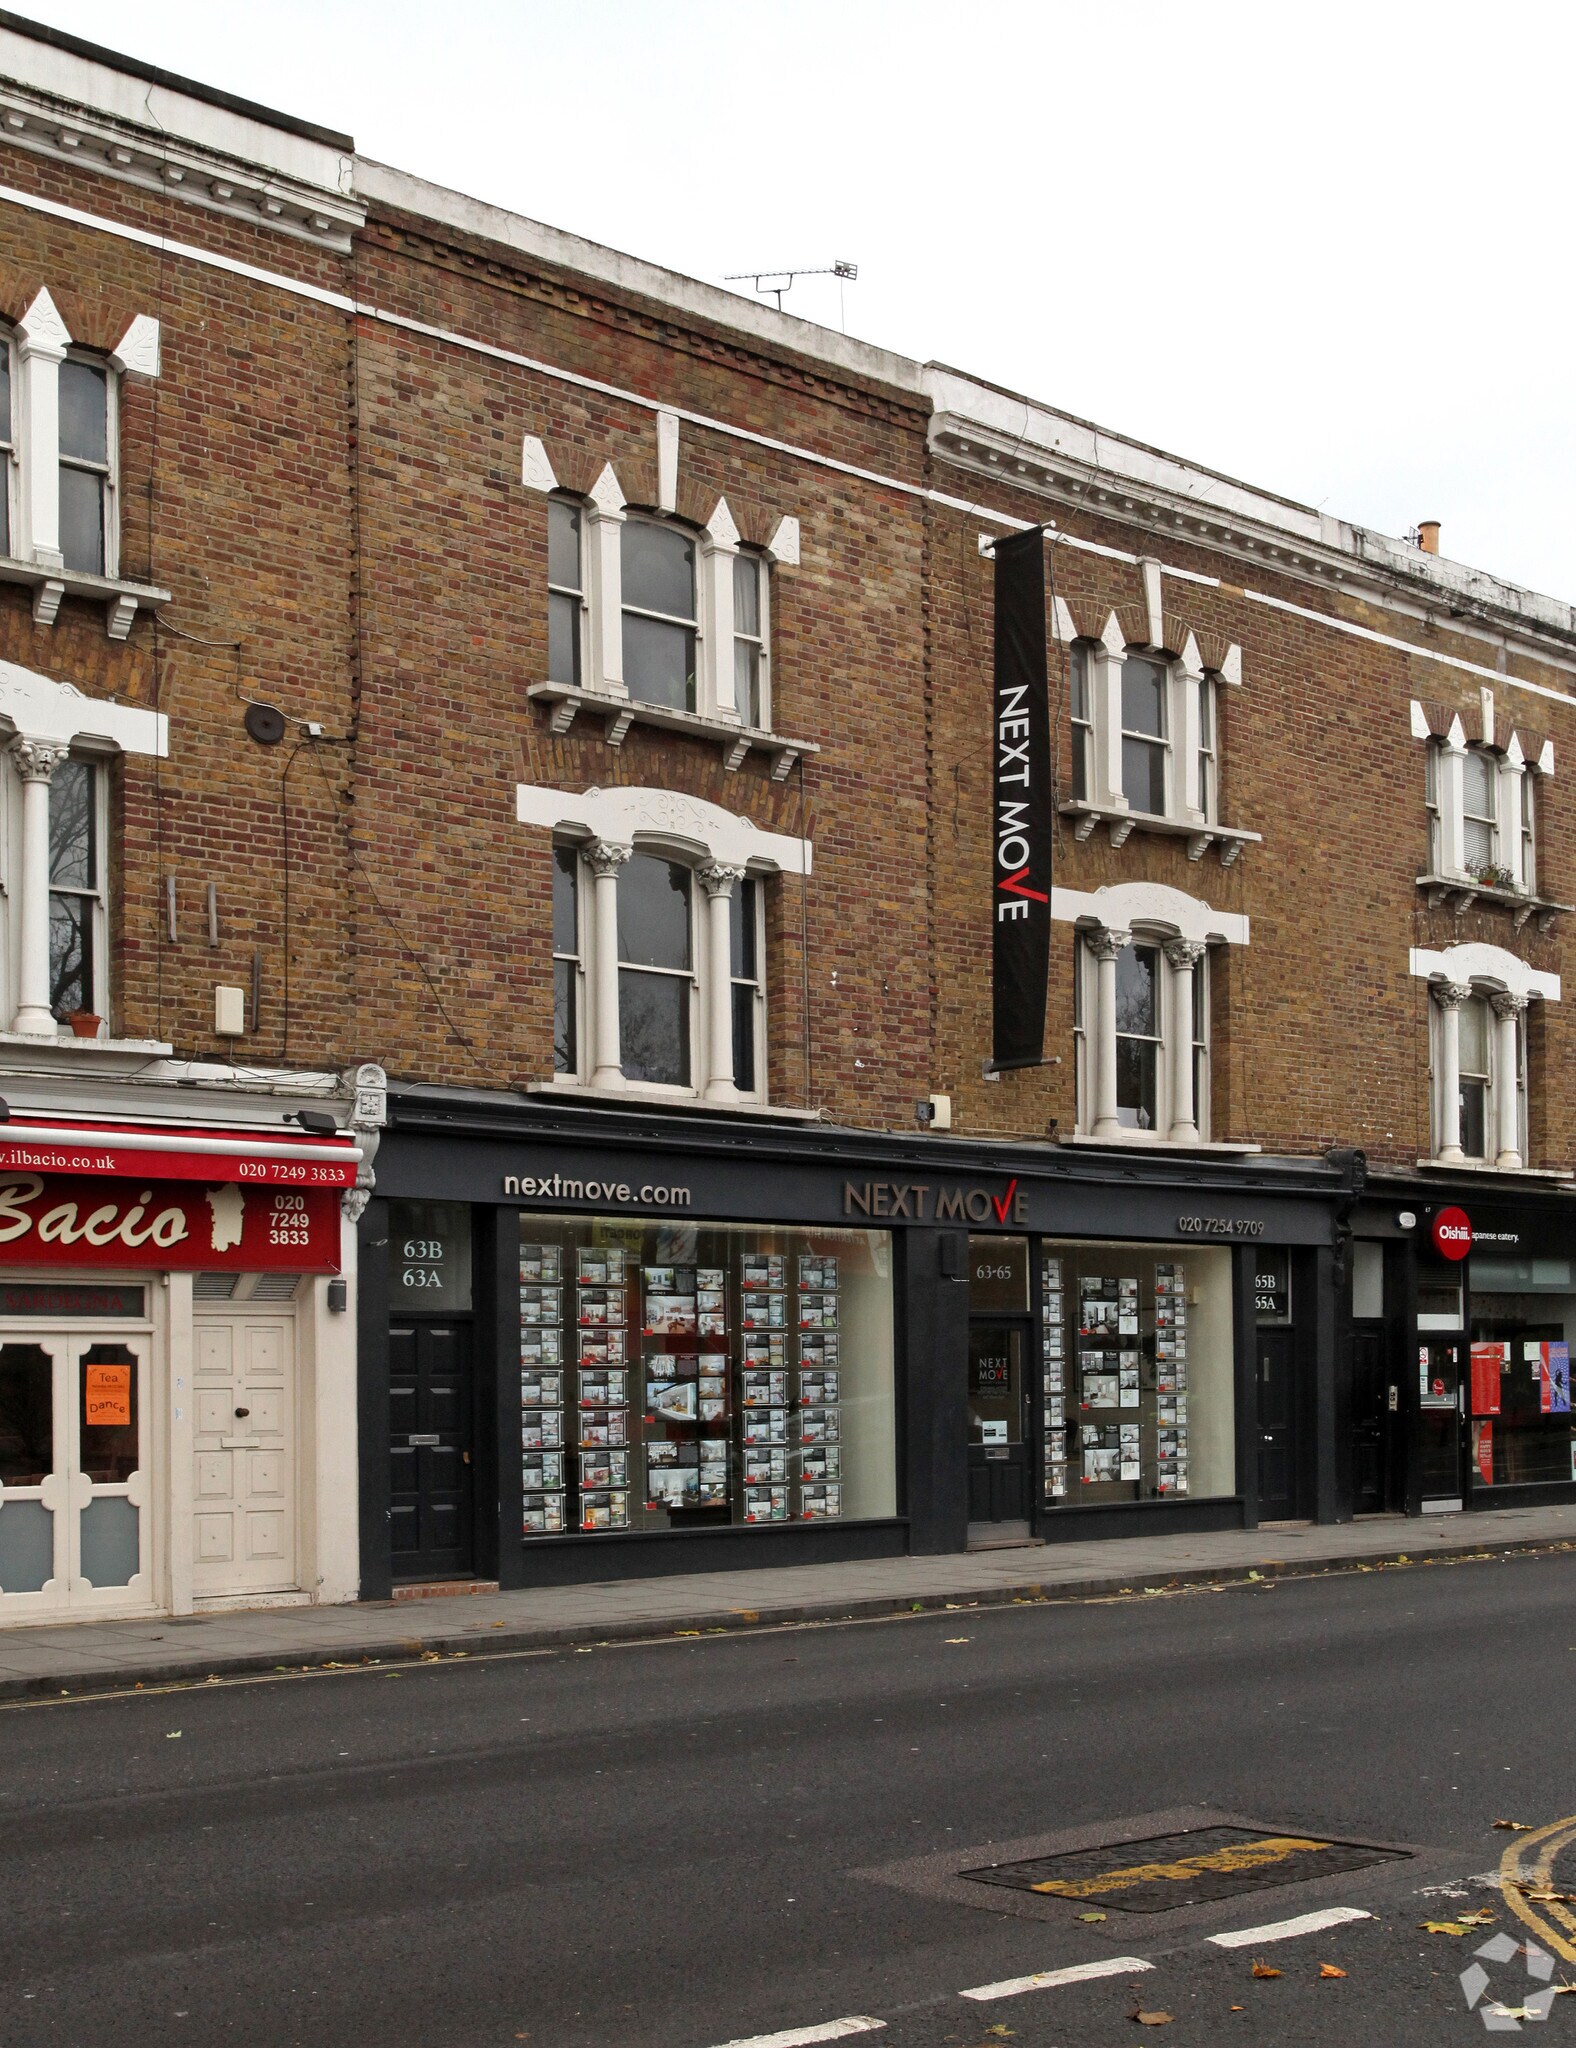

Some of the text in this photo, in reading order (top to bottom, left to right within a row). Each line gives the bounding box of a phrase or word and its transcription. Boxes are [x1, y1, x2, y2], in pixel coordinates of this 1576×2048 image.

[997, 684, 1049, 922] NEXT MOVE
[239, 1163, 346, 1181] 020 7249 3833
[504, 1173, 691, 1205] nextmove.com
[275, 1195, 304, 1210] 020
[844, 1179, 1029, 1224] NEXT MOVE
[0, 1172, 189, 1248] Bacio
[269, 1212, 309, 1228] 7249
[1179, 1217, 1264, 1236] 020 7254 9709
[269, 1230, 309, 1245] 3833
[1471, 1231, 1497, 1242] apanese
[403, 1240, 443, 1259] 63B
[402, 1269, 443, 1288] 63A
[976, 1264, 1012, 1280] 63-65
[1255, 1275, 1276, 1288] 65B
[979, 1358, 1007, 1368] NEXT
[99, 1372, 118, 1383] Tea
[979, 1366, 1008, 1380] MOVE
[90, 1401, 125, 1413] Dance
